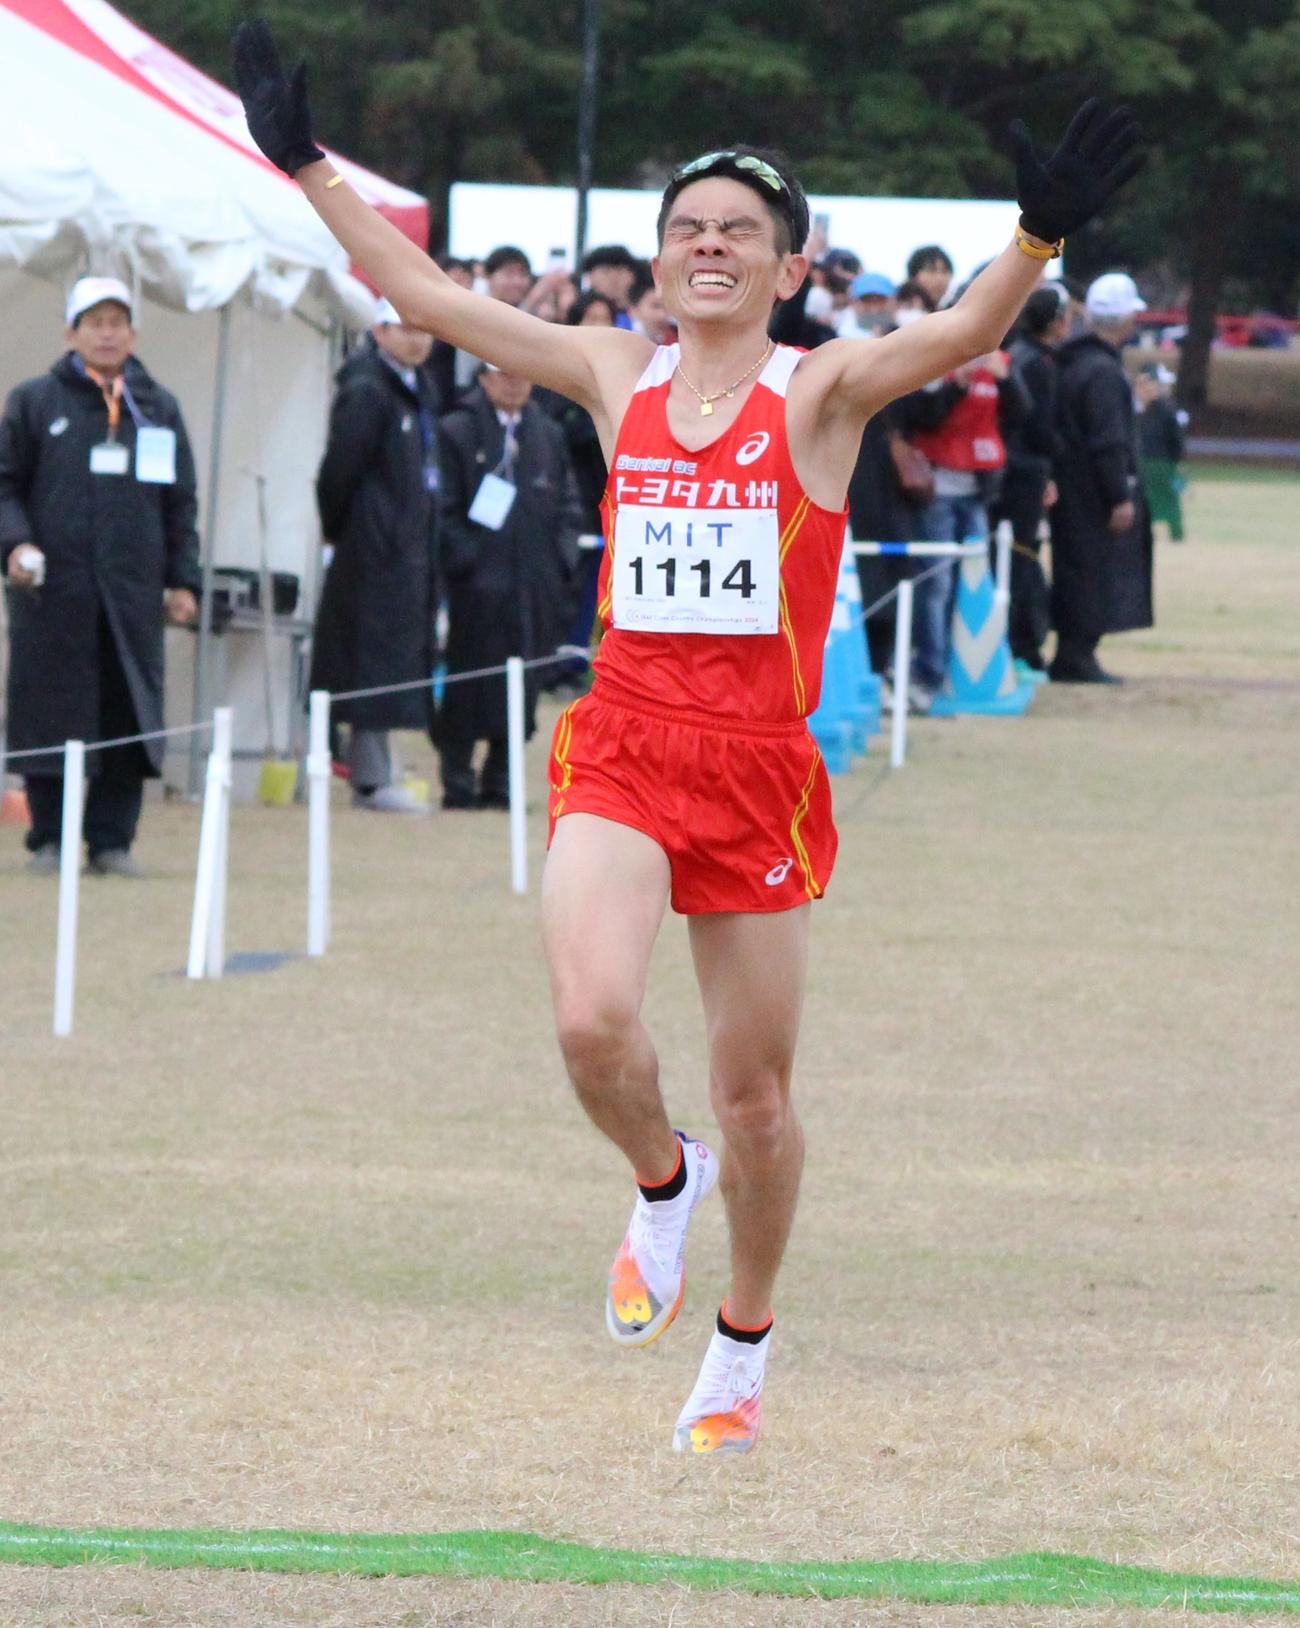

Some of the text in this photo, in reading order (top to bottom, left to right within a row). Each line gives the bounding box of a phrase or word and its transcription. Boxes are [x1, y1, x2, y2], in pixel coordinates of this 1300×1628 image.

[616, 477, 778, 507] トヨタ九州
[645, 520, 733, 547] MIT
[629, 557, 757, 598] 1114
